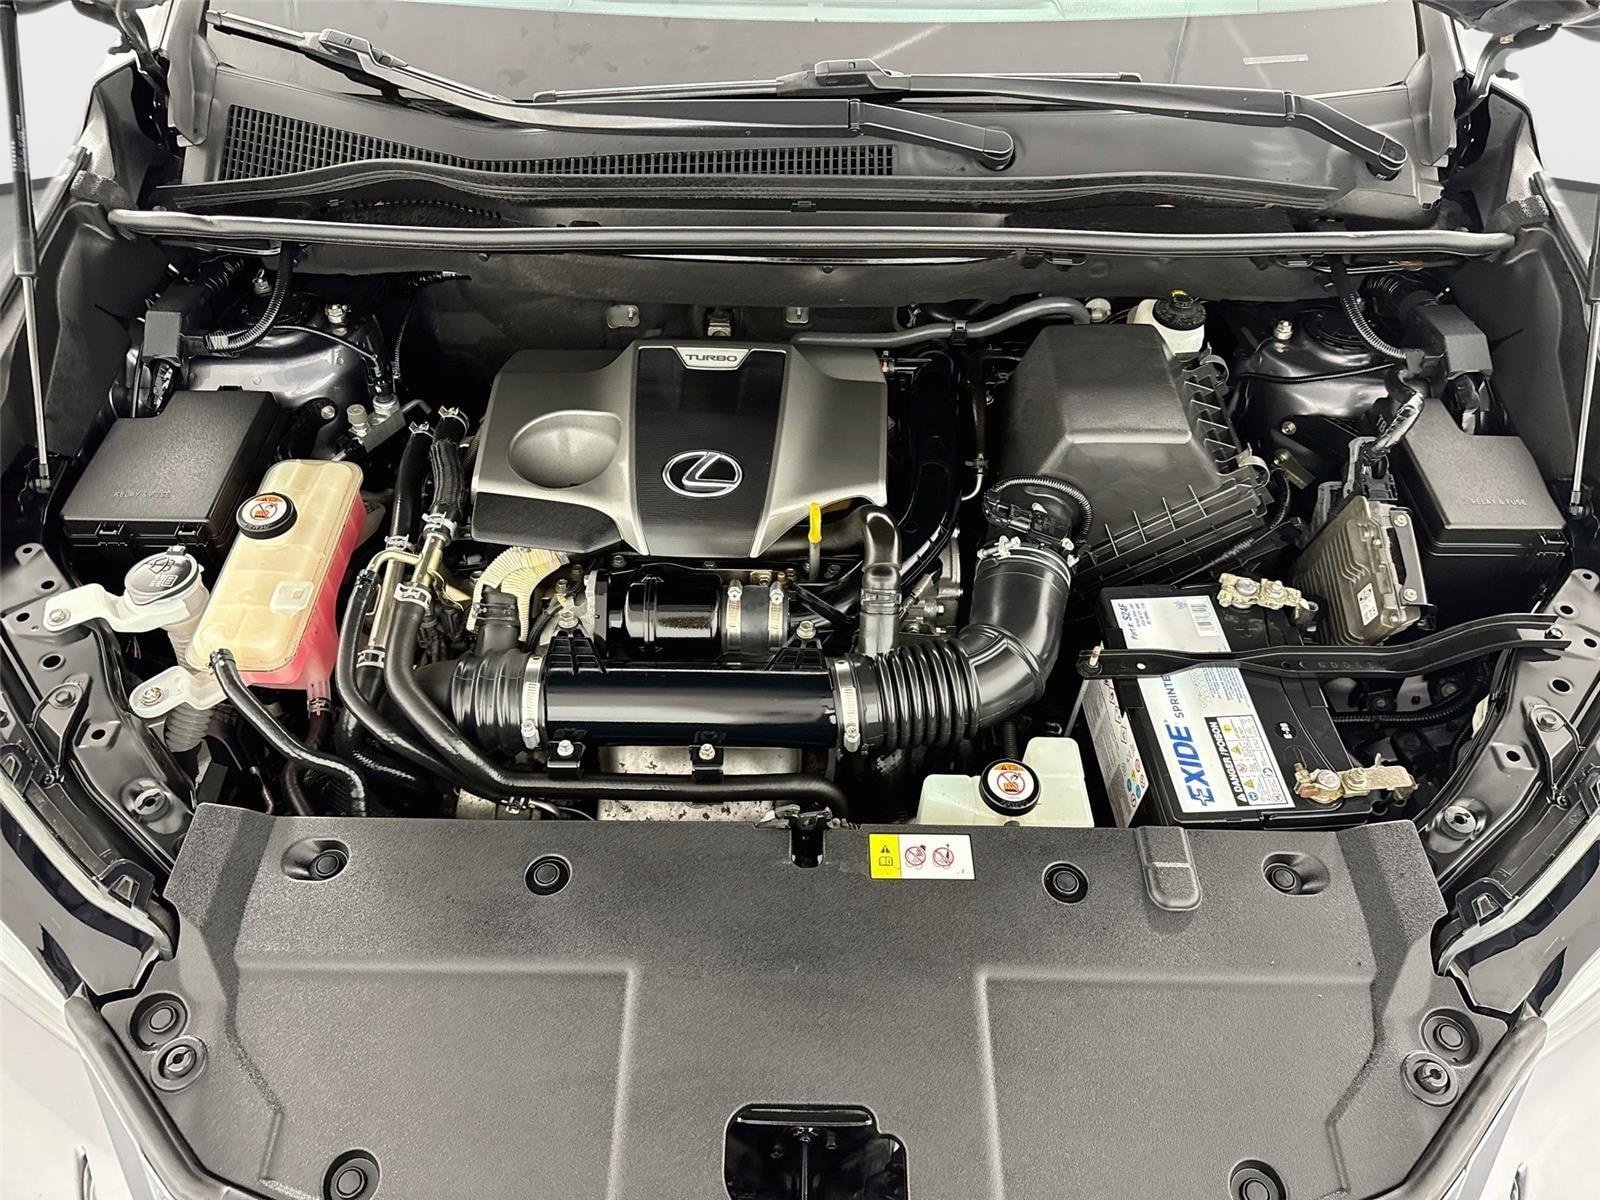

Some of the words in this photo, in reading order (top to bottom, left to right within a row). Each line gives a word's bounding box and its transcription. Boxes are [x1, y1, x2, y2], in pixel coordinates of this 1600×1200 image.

[684, 354, 738, 362] TURBO
[1161, 674, 1184, 718] SPRINTE
[1165, 723, 1215, 806] EXIDE
[1223, 756, 1243, 793] DANGER
